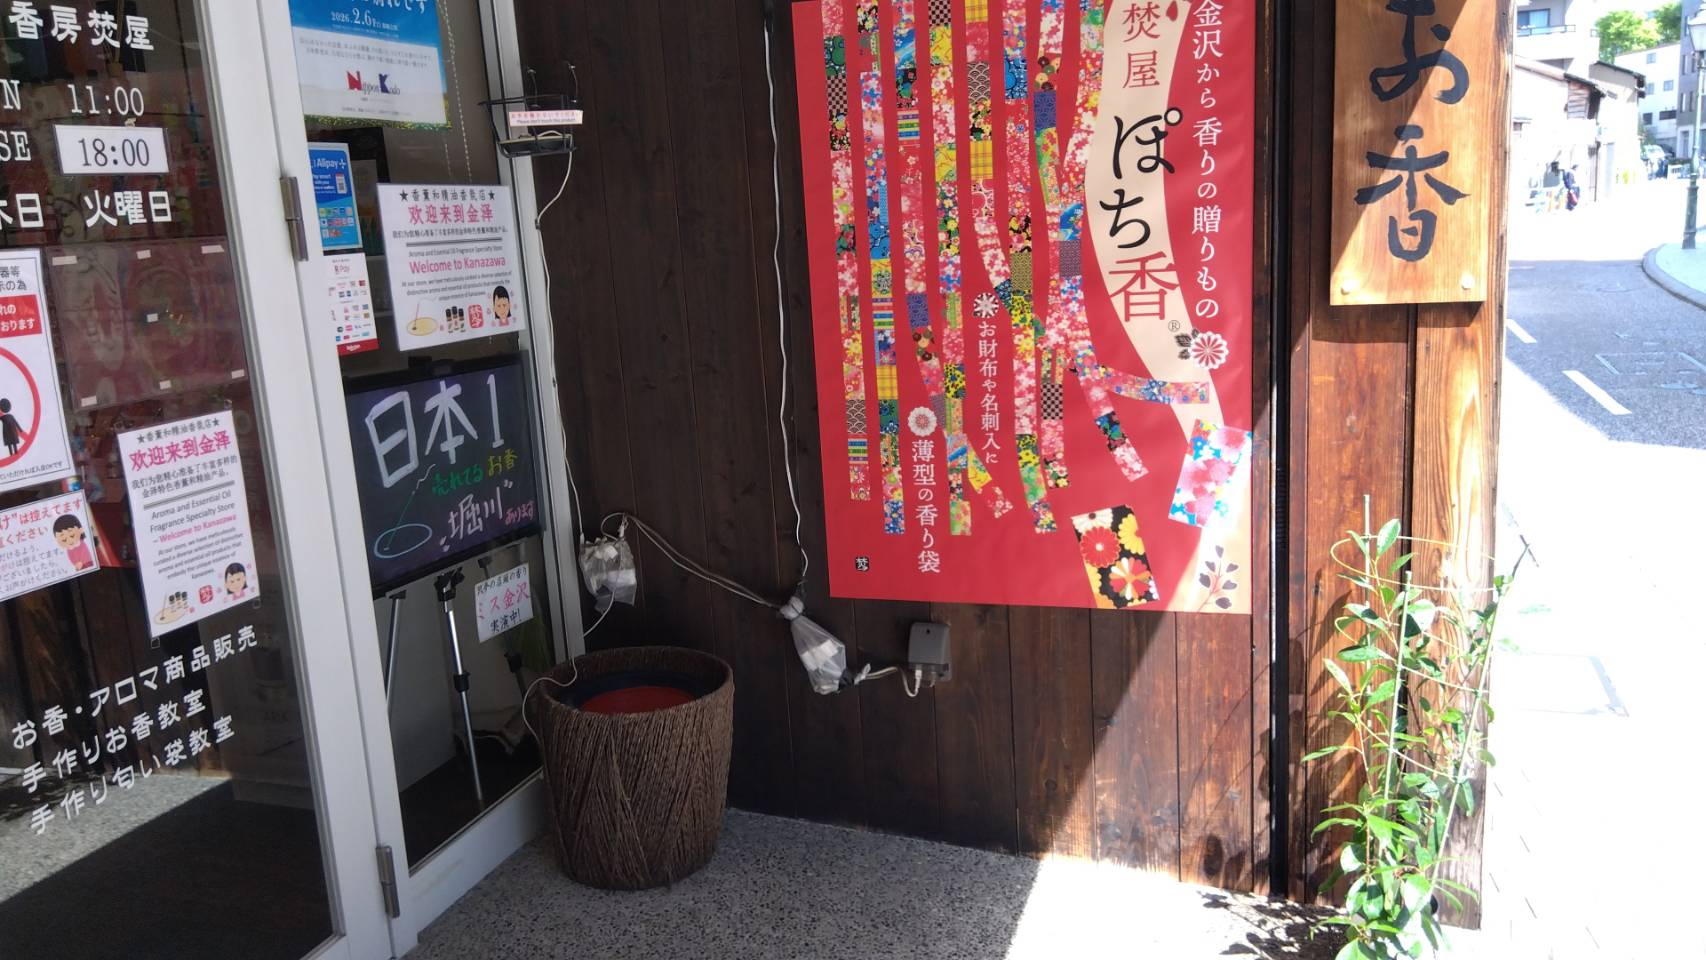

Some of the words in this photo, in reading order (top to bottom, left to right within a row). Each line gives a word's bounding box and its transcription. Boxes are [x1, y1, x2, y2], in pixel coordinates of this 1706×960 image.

[9, 1, 154, 50] 香房焚屋
[67, 84, 145, 117] 11:00
[78, 138, 150, 167] 18:00
[1354, 0, 1471, 262] お香
[1191, 0, 1224, 319] 金沢から香りの贈りもの
[83, 190, 172, 227] 火曜日
[408, 203, 494, 225] 欢迎来到金泽
[1099, 107, 1183, 323] ぽち香
[409, 259, 452, 274] Welcome
[454, 258, 462, 270] to
[464, 255, 506, 269] Kanazawa
[978, 321, 1001, 464] お財布や名刺入に
[129, 430, 231, 471] 欢迎来到金泽
[176, 502, 191, 511] and
[217, 502, 236, 512] Store
[912, 440, 941, 574] 薄型の香り袋
[12, 625, 257, 749] お香・アロマ商品販売
[22, 689, 206, 793] 手作りお香教室
[31, 715, 235, 835] 手作り匂い袋教室
